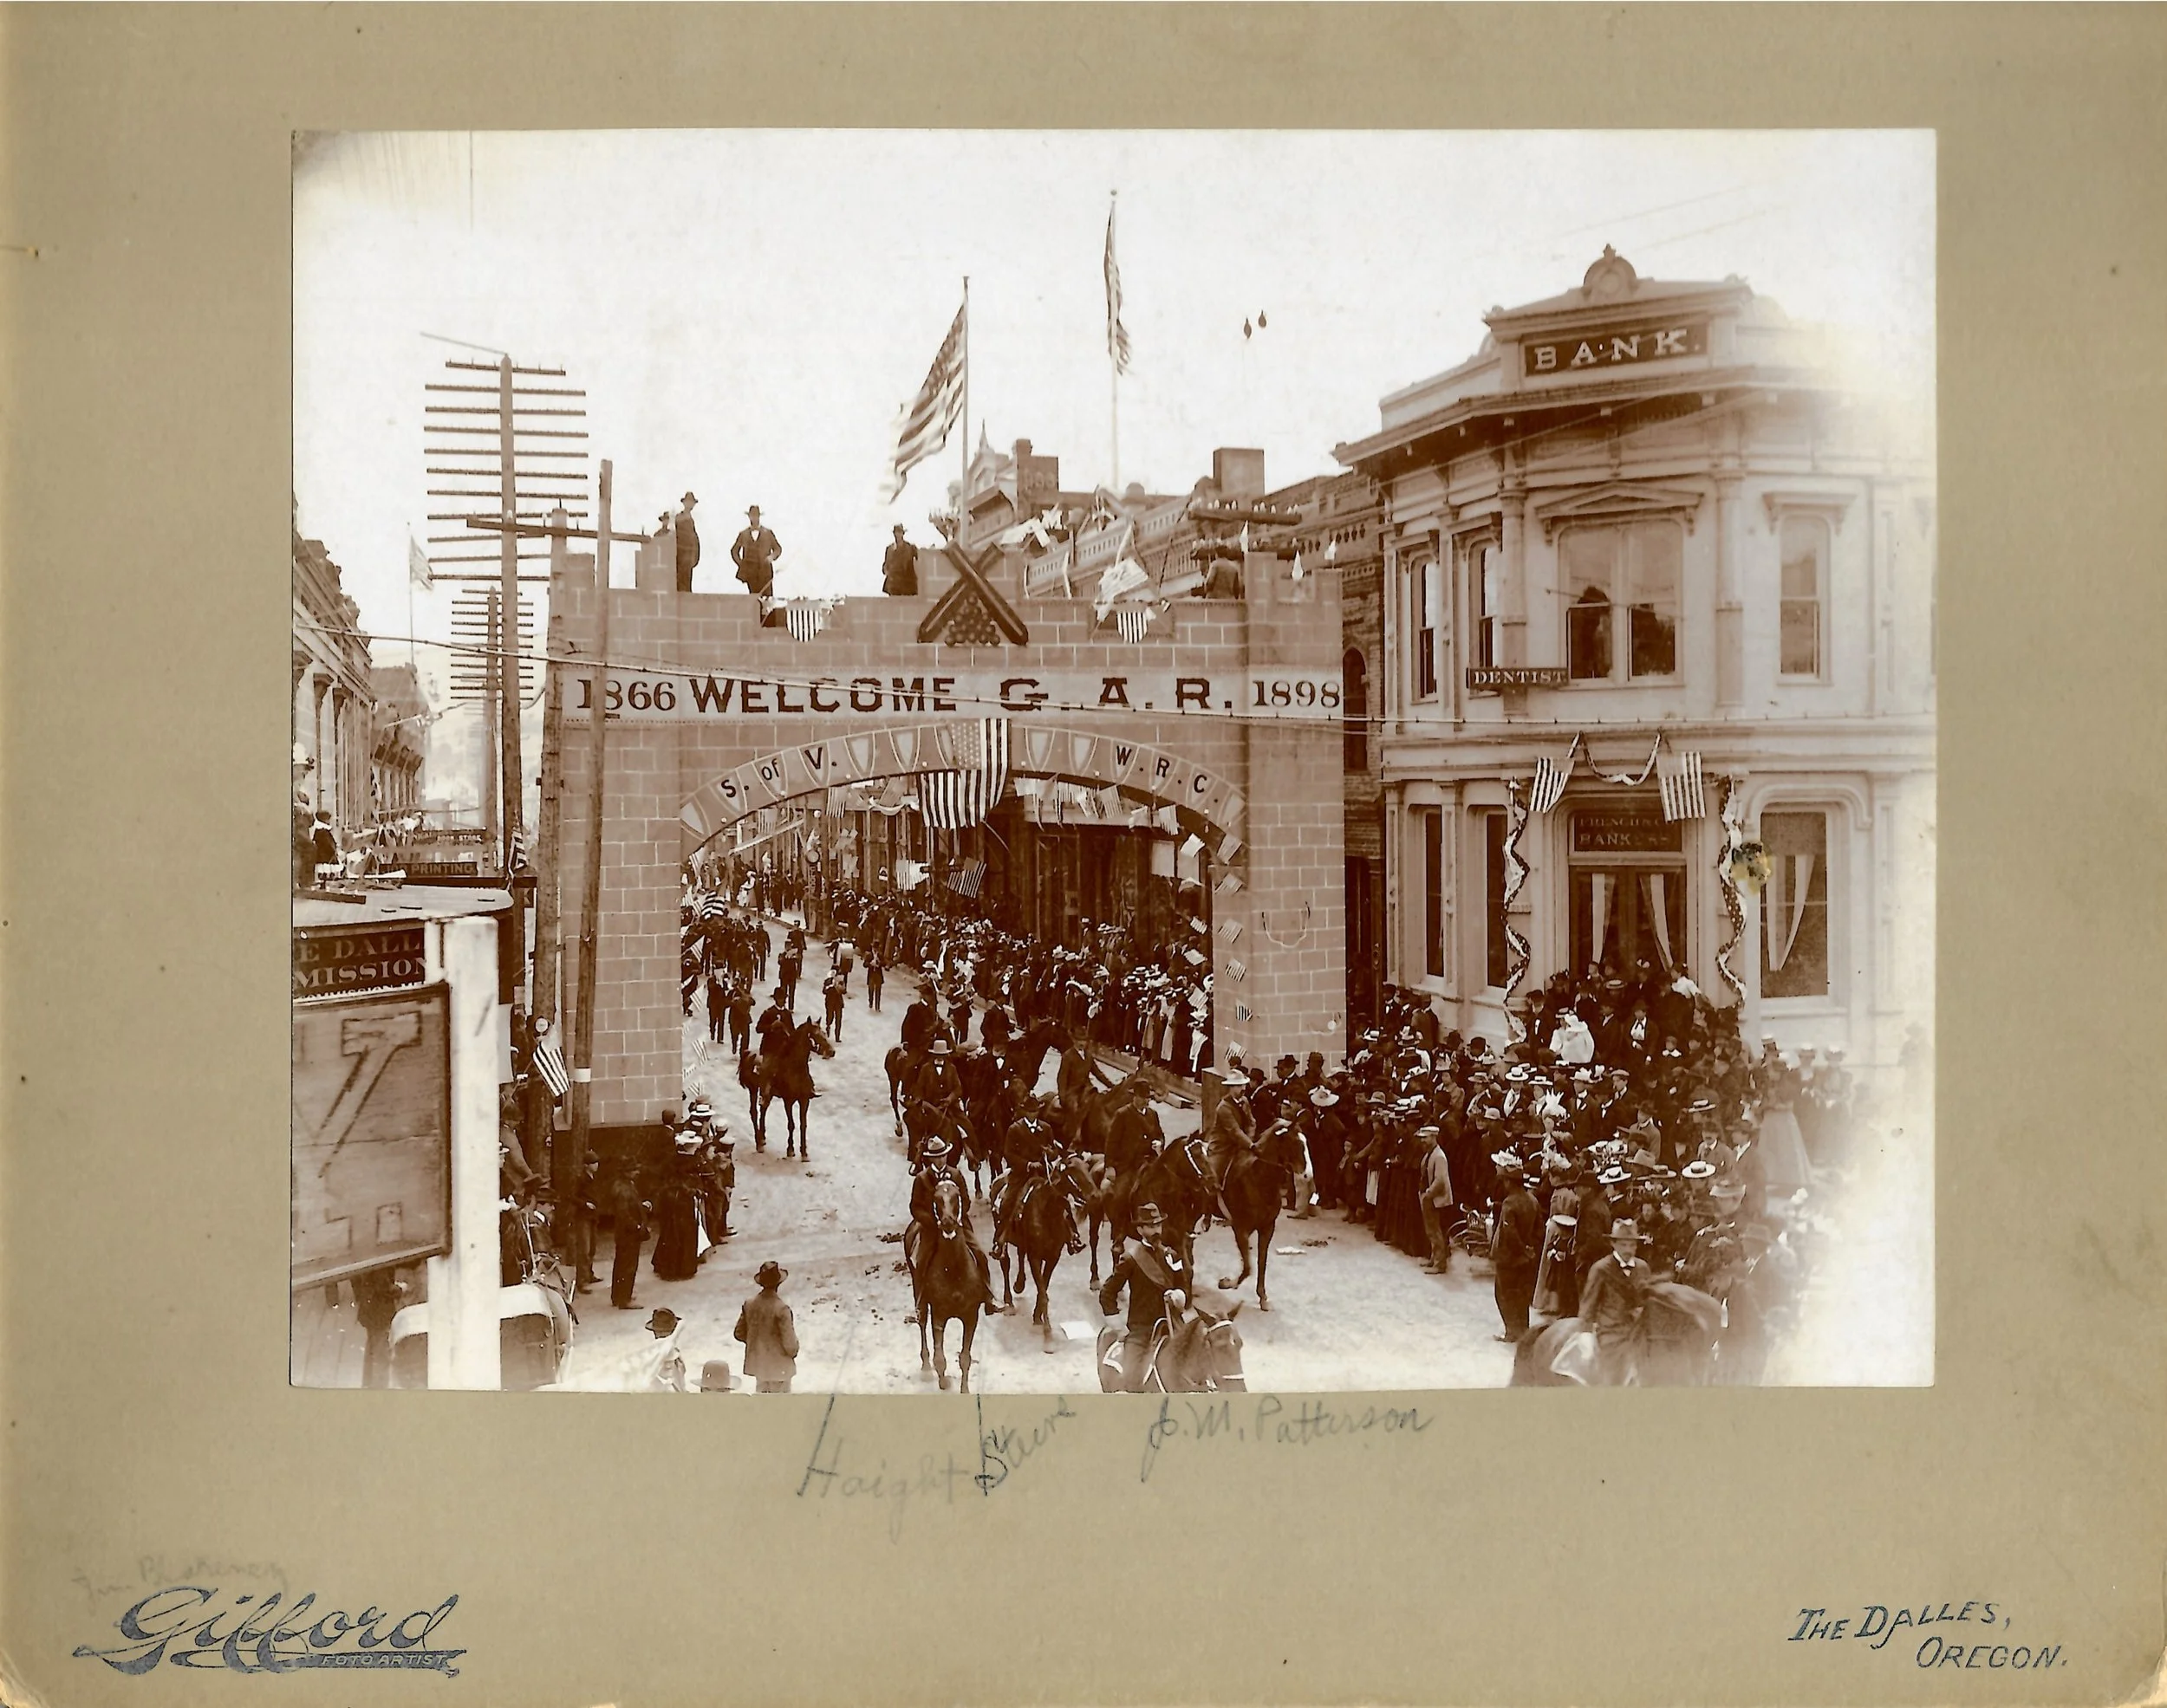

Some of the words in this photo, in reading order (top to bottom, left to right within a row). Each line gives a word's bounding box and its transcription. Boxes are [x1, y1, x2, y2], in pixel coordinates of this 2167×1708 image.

[576, 679, 676, 711] 1866
[689, 677, 957, 713] WELCOME
[1253, 679, 1340, 708] 1898
[761, 757, 779, 781] of
[412, 862, 474, 875] PRINTING
[1256, 1395, 1435, 1446] Patterson
[73, 1586, 460, 1675] Gifford
[1853, 1601, 2012, 1650] DALLES,
[322, 1654, 374, 1666] FOTO
[1915, 1635, 2068, 1670] OREGON.
